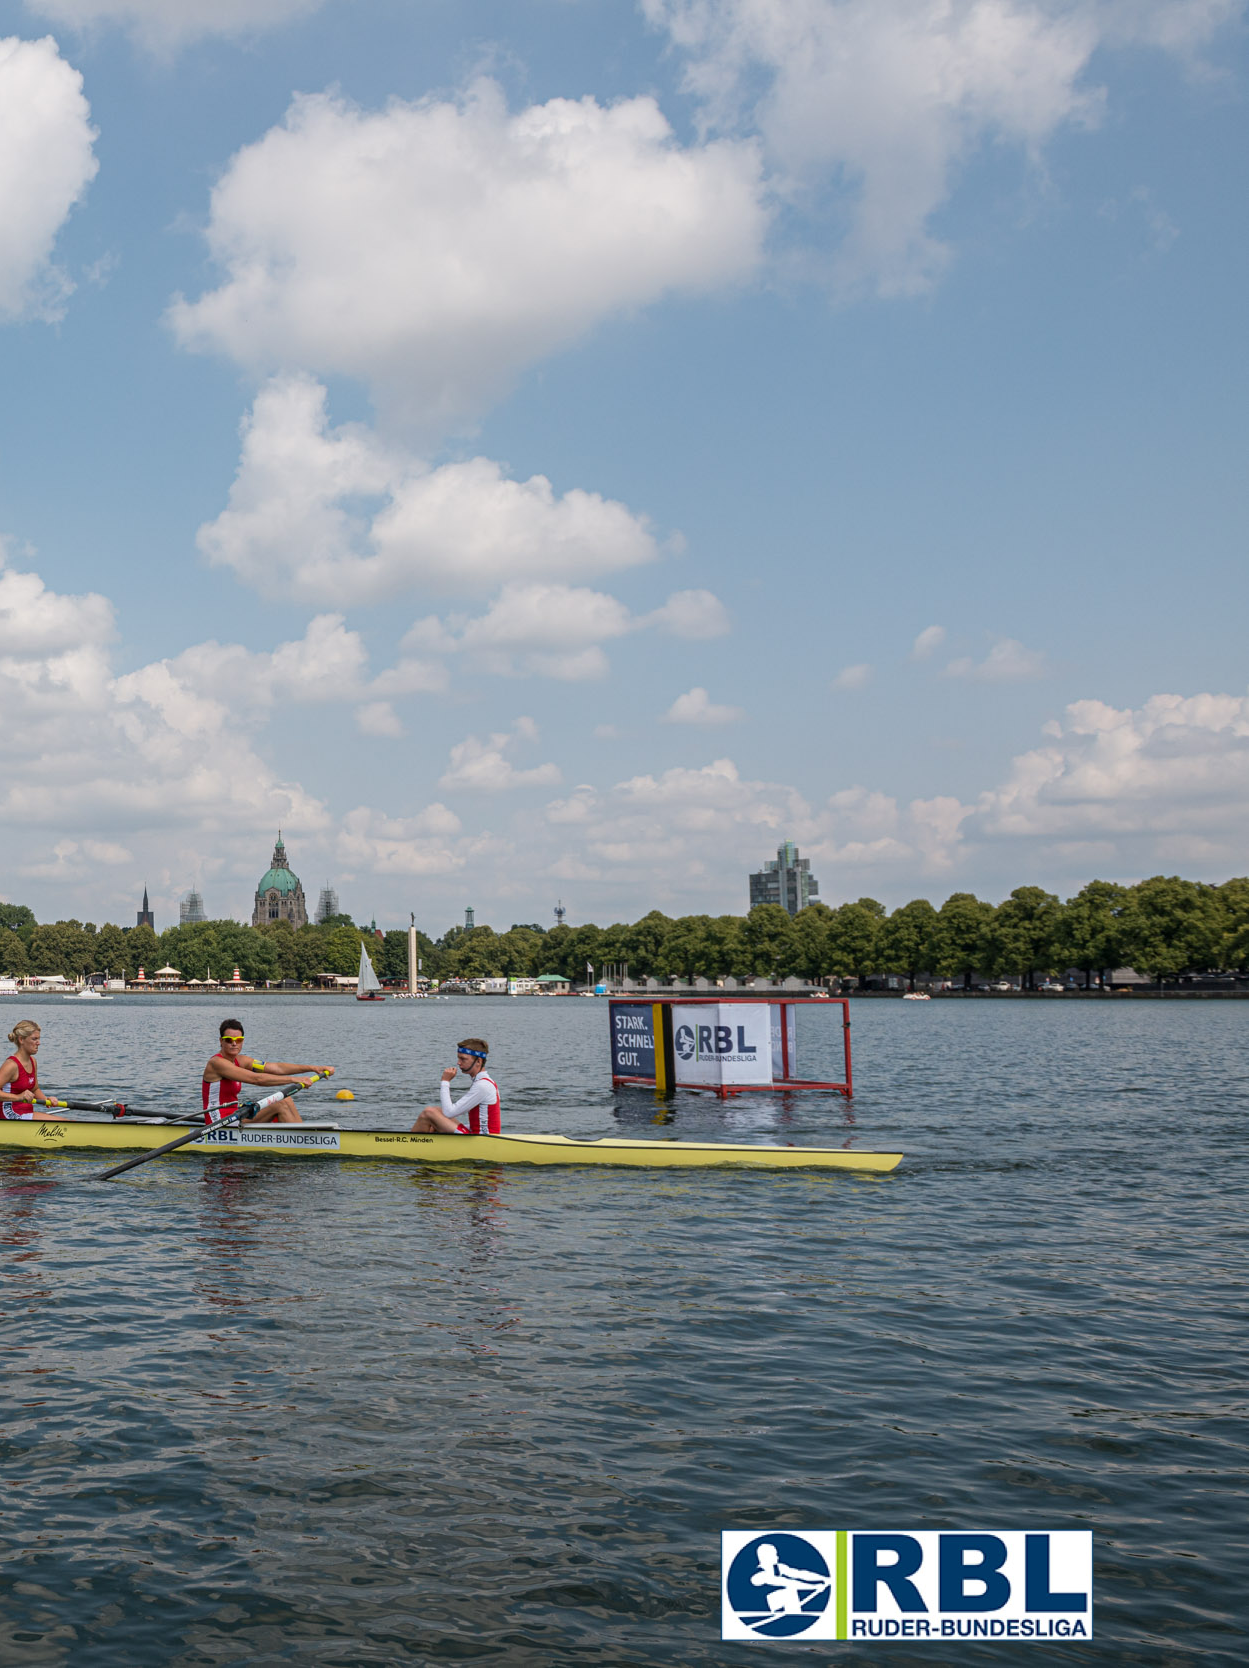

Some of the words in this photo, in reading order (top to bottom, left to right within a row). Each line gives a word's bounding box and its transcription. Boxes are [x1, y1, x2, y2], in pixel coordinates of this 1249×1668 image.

[615, 1015, 648, 1030] STARK.
[617, 1033, 654, 1049] SCHNEL
[699, 1025, 756, 1053] RBL
[617, 1051, 640, 1066] GUT.
[699, 1054, 757, 1062] RUDER-BUNDESLIGA
[35, 1123, 64, 1137] Melitta
[207, 1130, 237, 1141] RBL
[241, 1133, 337, 1145] RUDER-BUNDESLIGA
